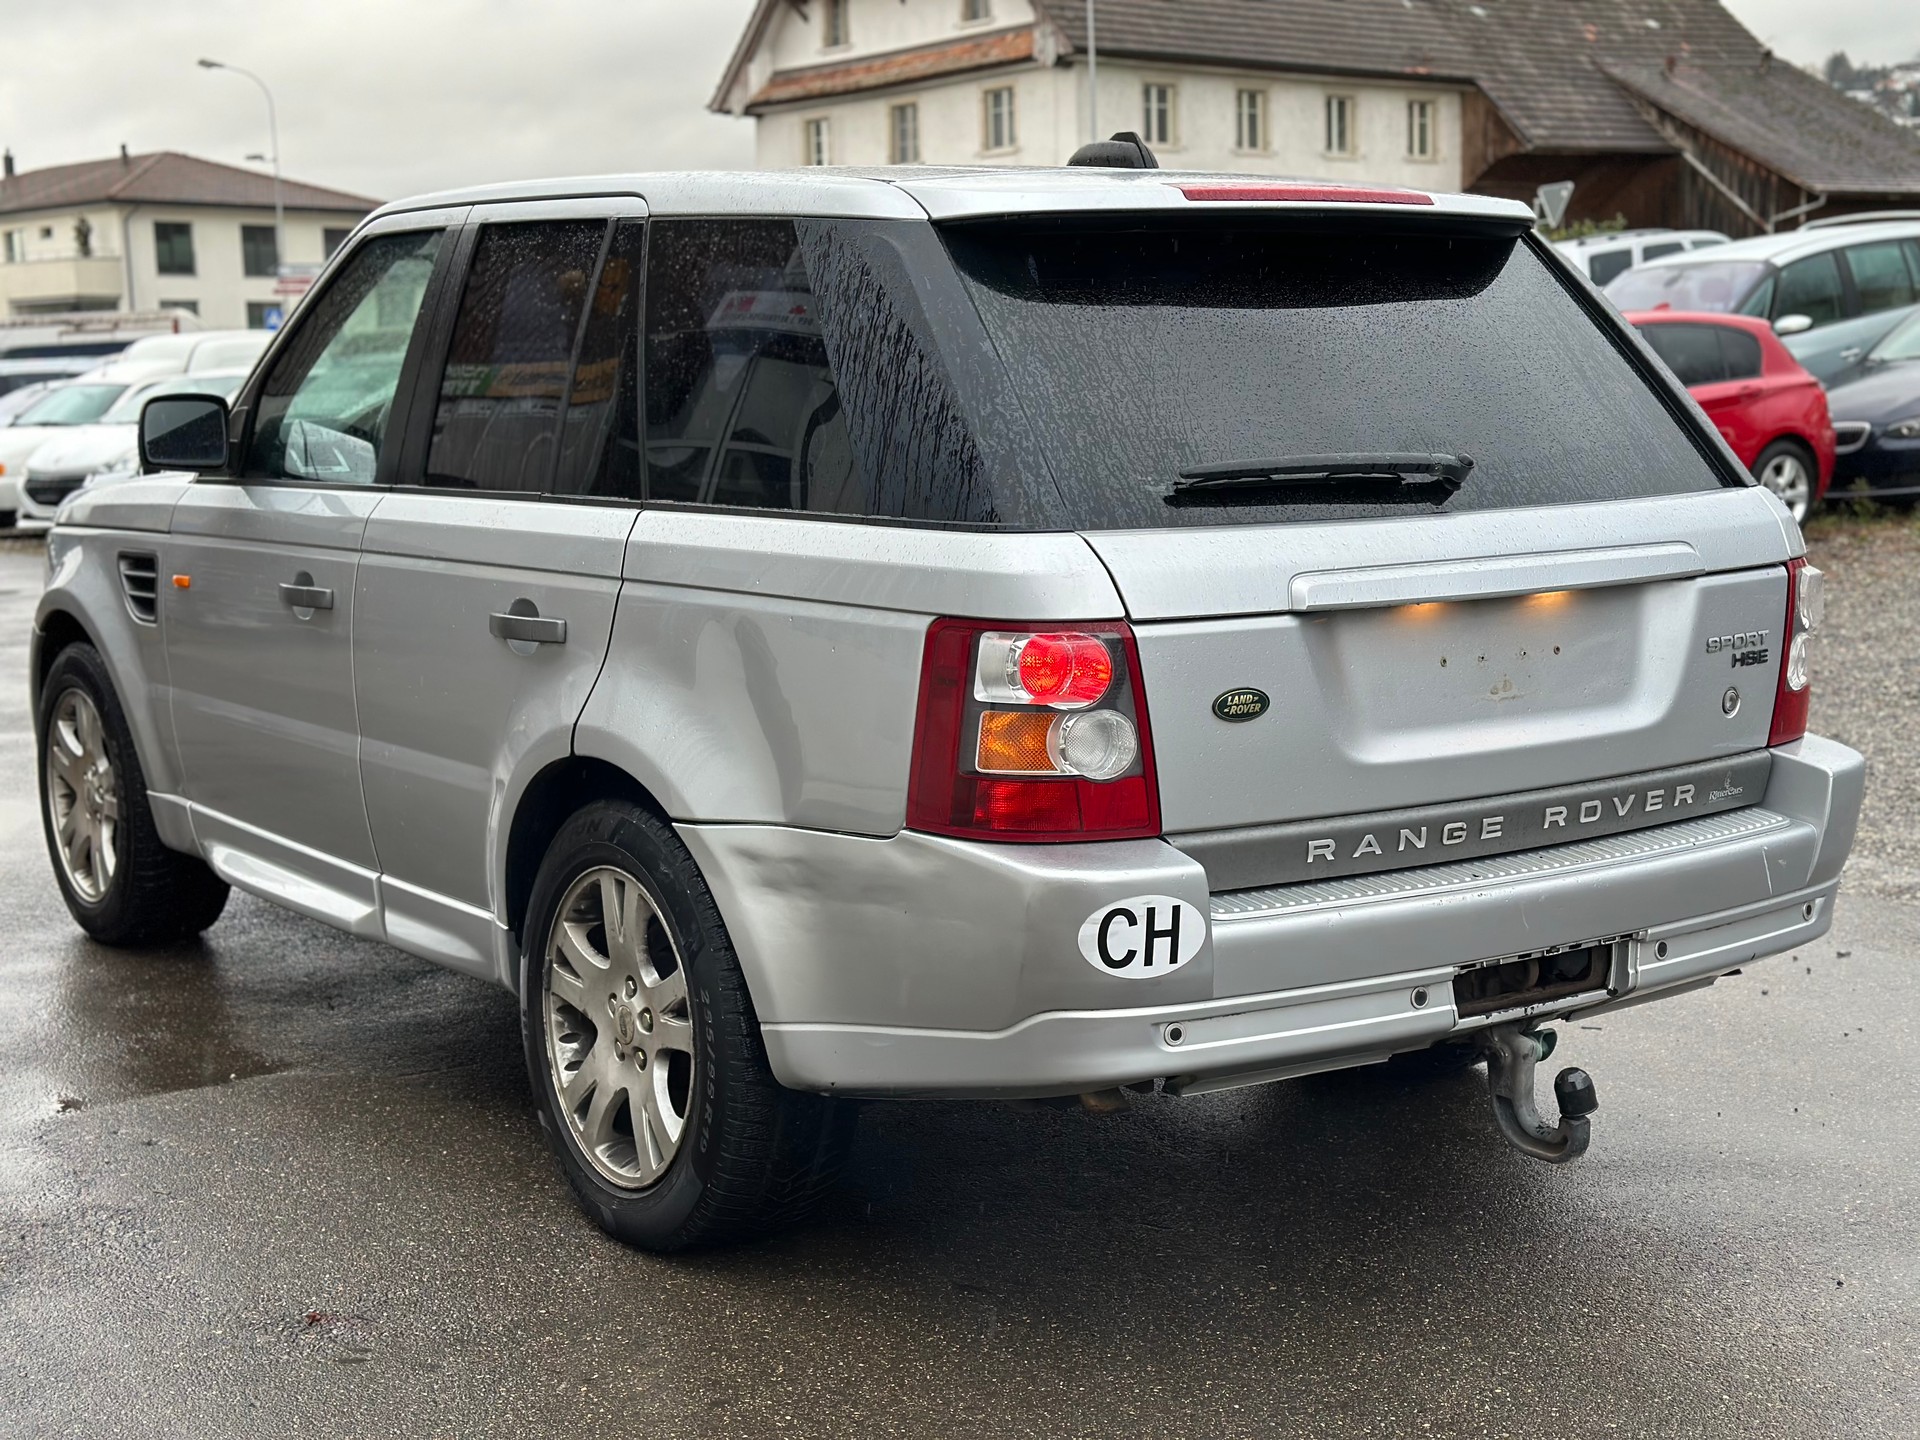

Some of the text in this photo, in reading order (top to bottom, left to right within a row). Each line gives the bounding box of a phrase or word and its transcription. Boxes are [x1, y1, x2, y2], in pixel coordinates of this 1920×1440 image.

[1706, 629, 1770, 654] SPORT
[1731, 648, 1769, 669] HSE
[1226, 694, 1253, 706] LAND
[1229, 703, 1262, 715] ROVER
[1306, 783, 1696, 863] RANGE ROVER
[1097, 904, 1181, 969] CH
